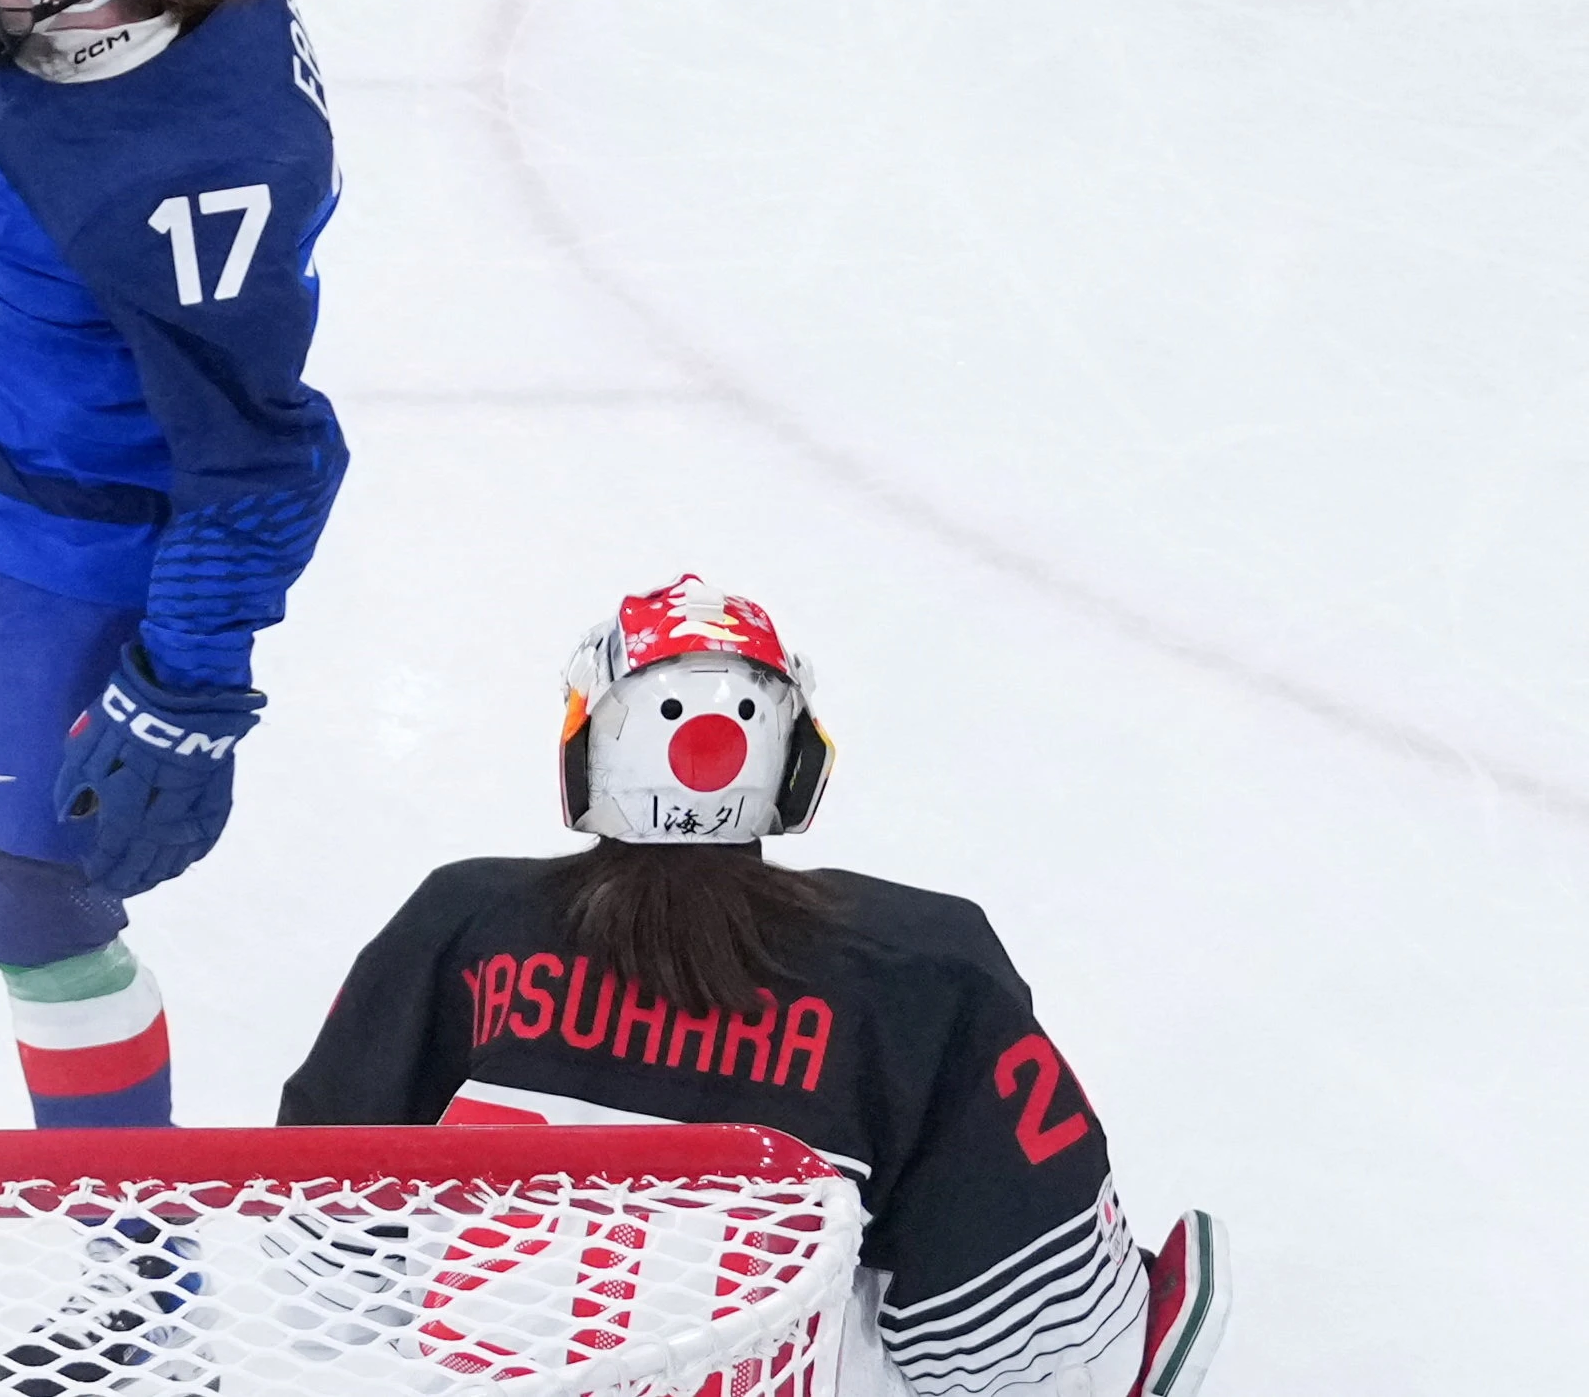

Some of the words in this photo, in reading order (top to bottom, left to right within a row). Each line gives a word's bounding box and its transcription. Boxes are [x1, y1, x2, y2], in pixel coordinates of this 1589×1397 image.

[73, 29, 131, 65] CCM
[147, 183, 273, 306] 17
[102, 683, 237, 760] CCM
[993, 1033, 1091, 1166] 2
